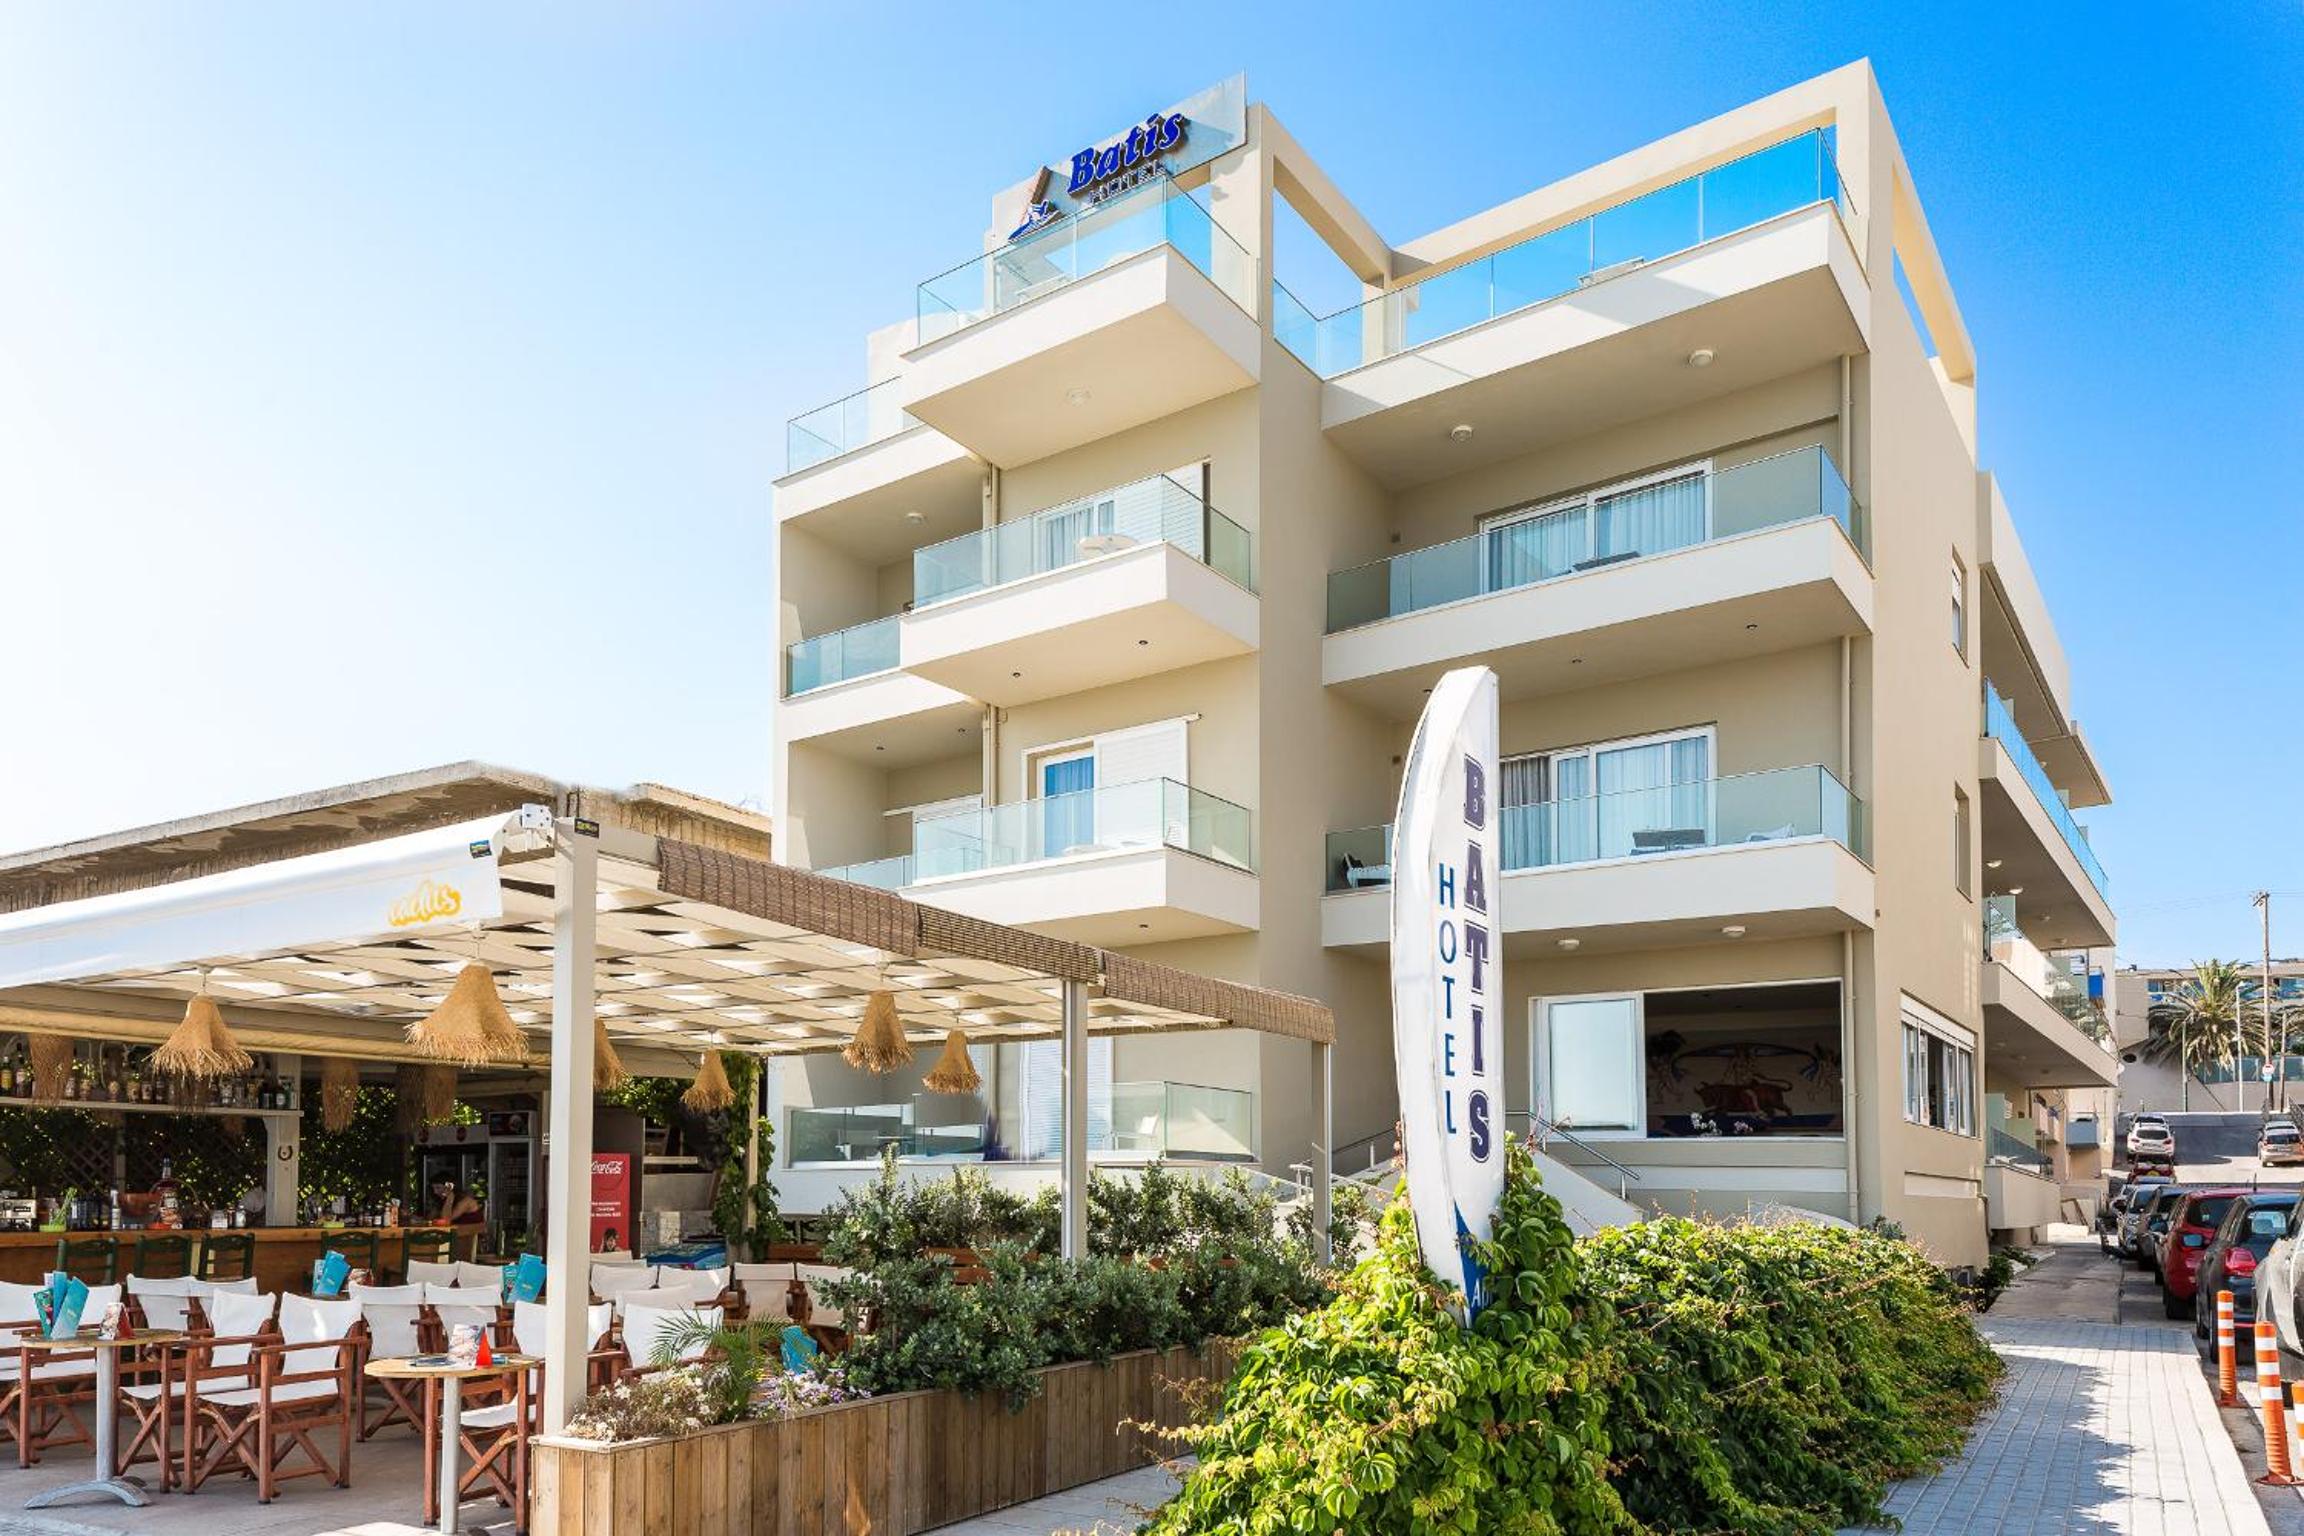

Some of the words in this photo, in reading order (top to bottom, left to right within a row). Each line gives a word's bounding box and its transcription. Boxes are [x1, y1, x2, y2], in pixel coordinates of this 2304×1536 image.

[1067, 112, 1185, 194] Batis
[1439, 862, 1457, 1135] HOTEL
[1463, 753, 1489, 1163] BATIS
